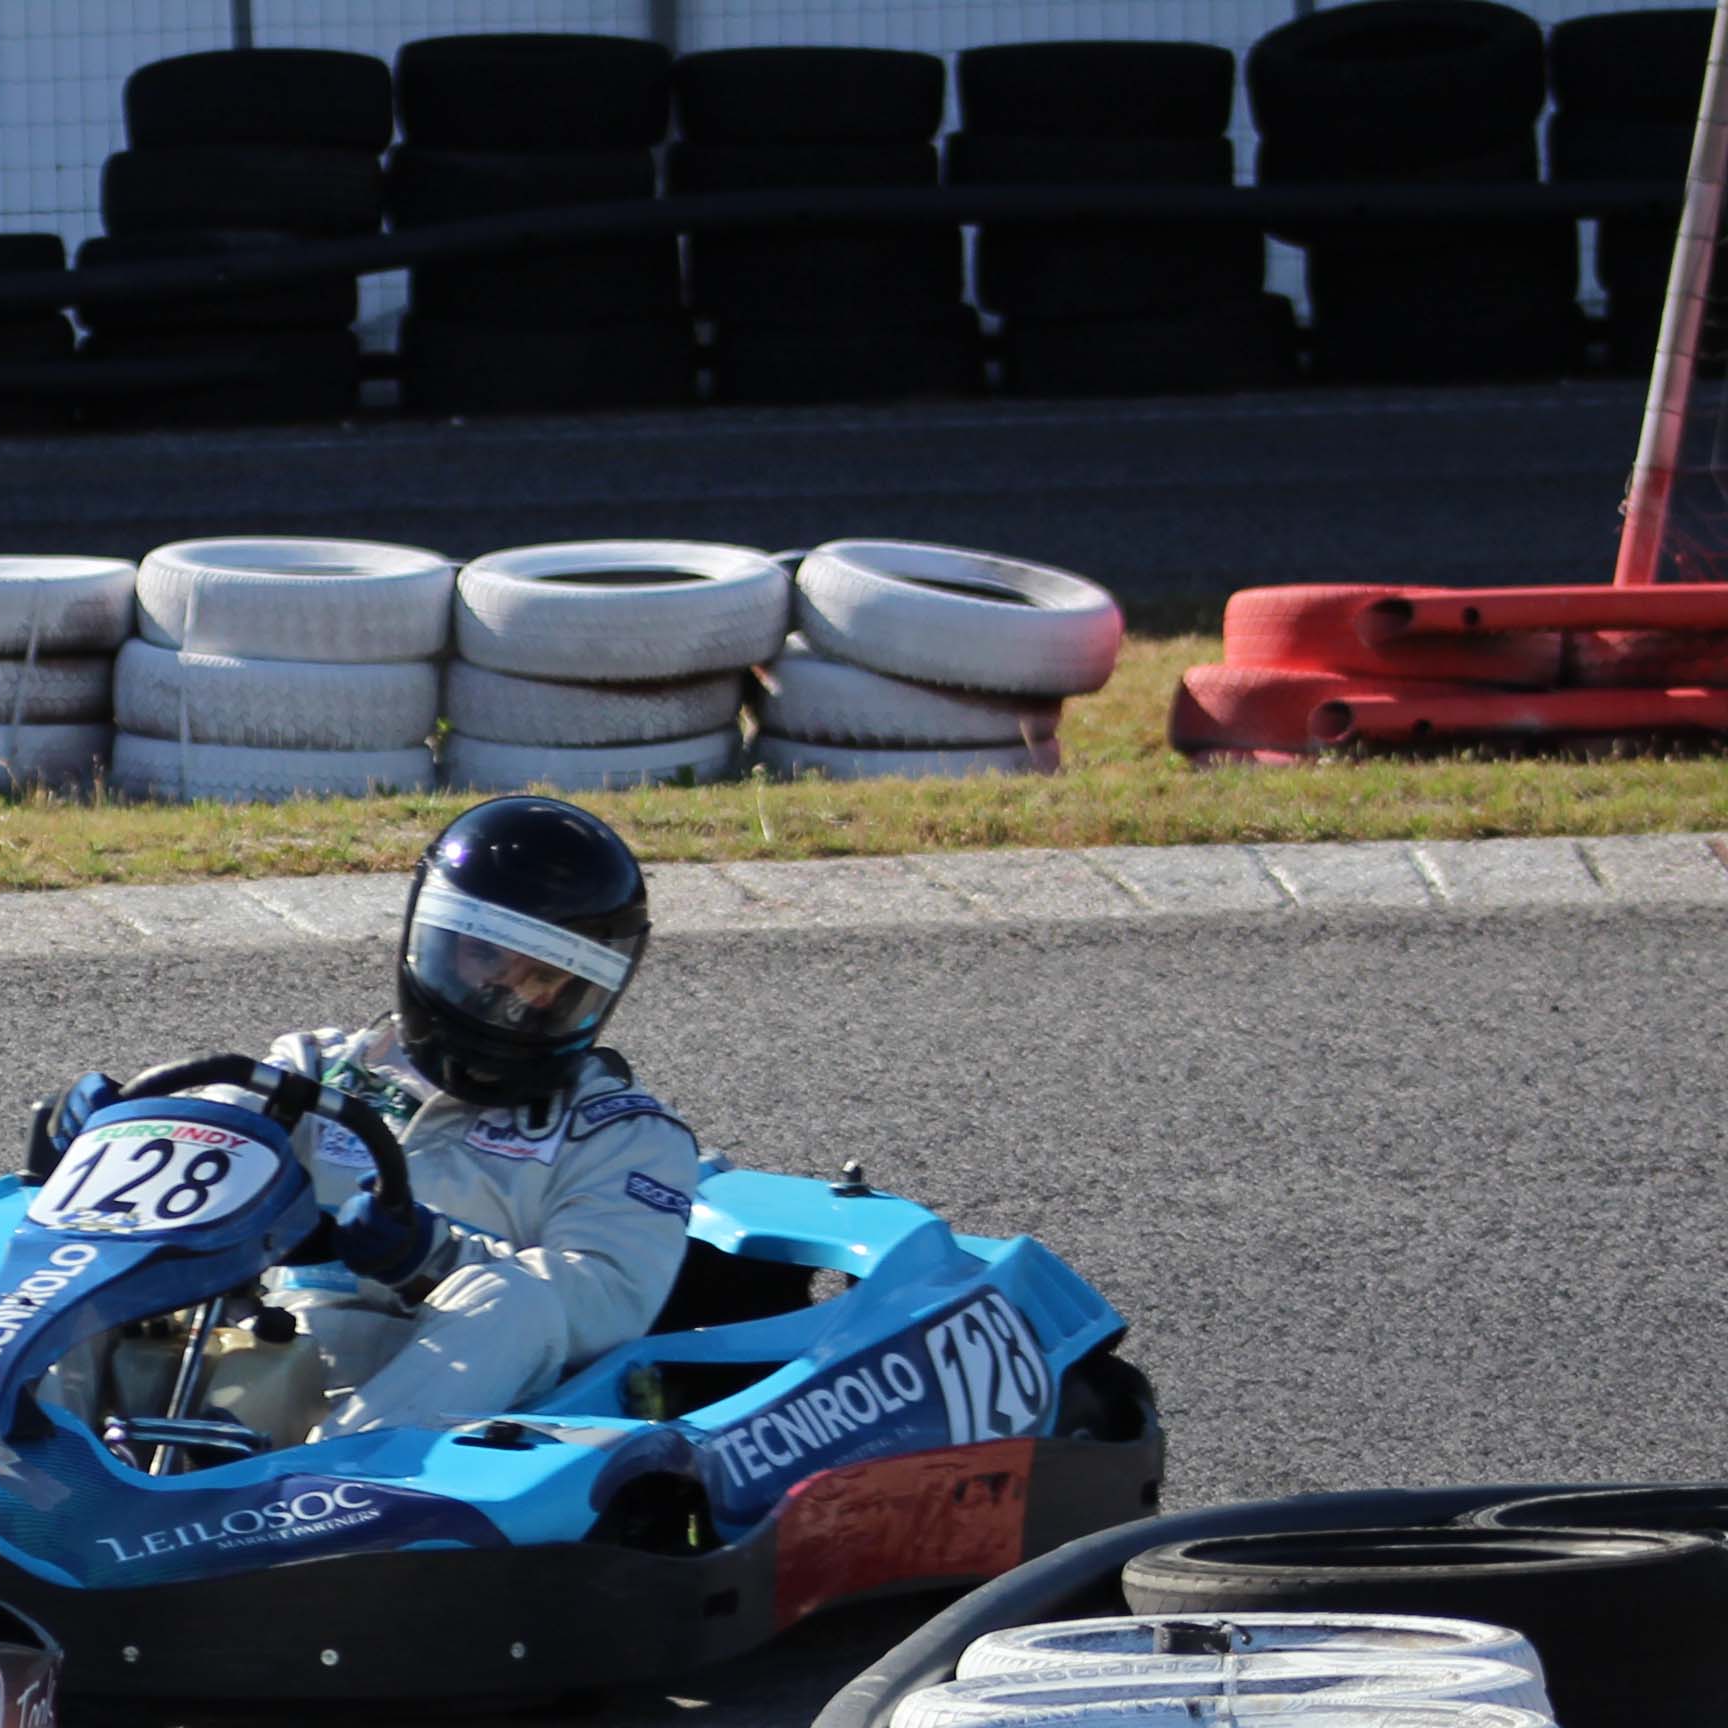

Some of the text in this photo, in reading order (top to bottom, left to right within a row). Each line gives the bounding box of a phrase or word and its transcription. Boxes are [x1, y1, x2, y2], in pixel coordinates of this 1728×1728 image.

[95, 1124, 250, 1150] EUROINDY
[52, 1138, 231, 1221] 128
[941, 1303, 1044, 1447] 128
[712, 1352, 926, 1488] TECNIROLO
[95, 1482, 374, 1564] LEILOSOC
[290, 1507, 382, 1538] PARTNERS
